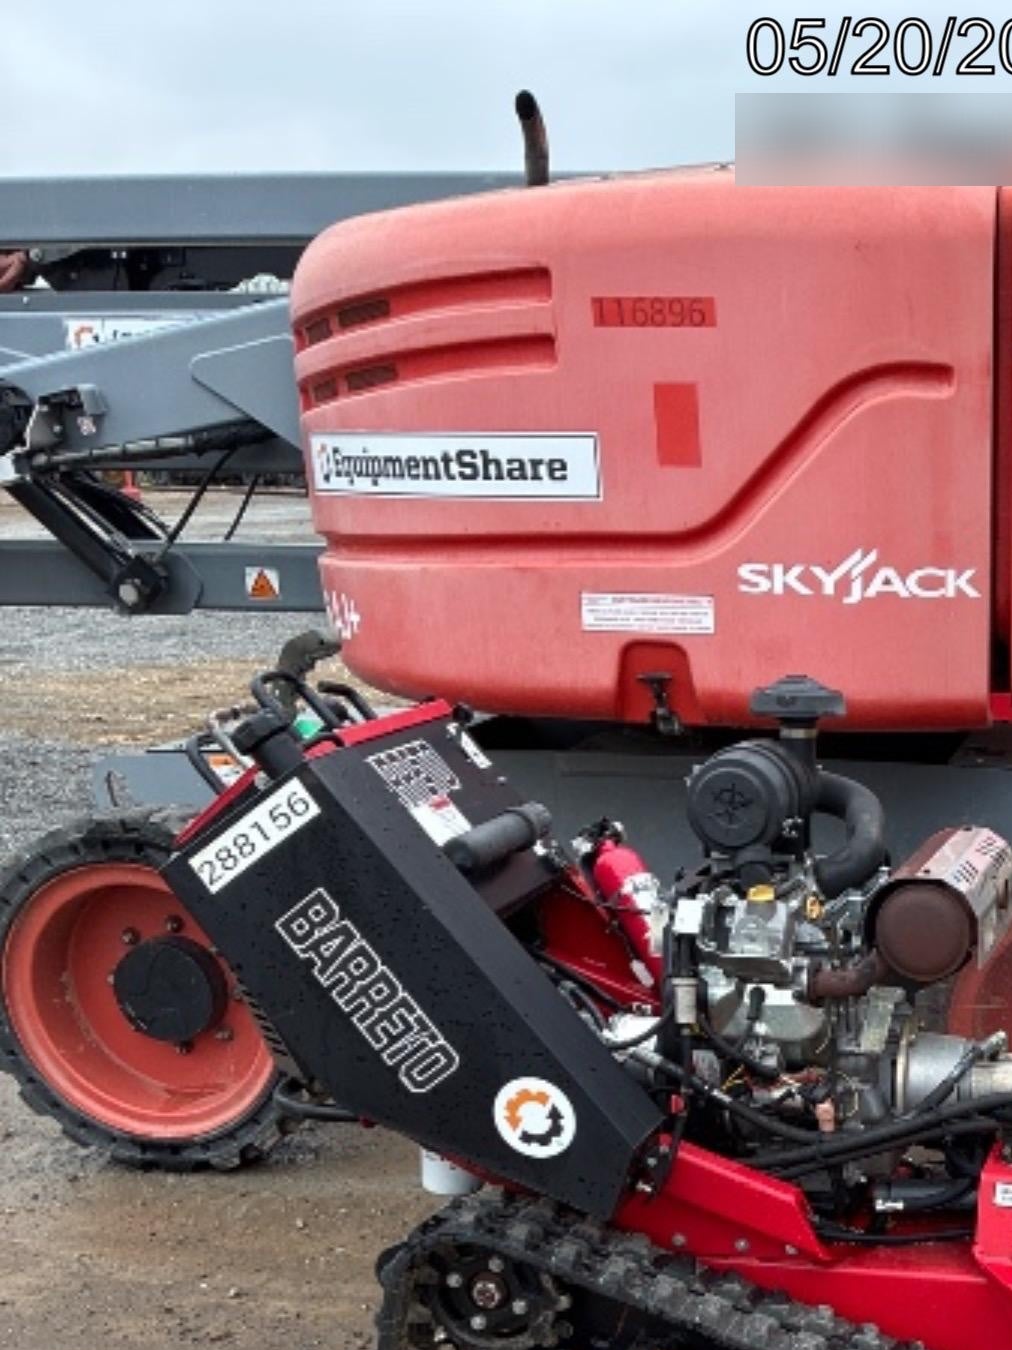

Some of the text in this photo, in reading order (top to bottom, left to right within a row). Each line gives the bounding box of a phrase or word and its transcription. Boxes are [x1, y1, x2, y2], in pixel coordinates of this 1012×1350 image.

[591, 297, 706, 327] 116896
[332, 447, 568, 486] EquipmentShare
[737, 548, 982, 604] SKYJACK
[197, 790, 310, 886] 288156
[275, 887, 460, 1093] BARRETO
